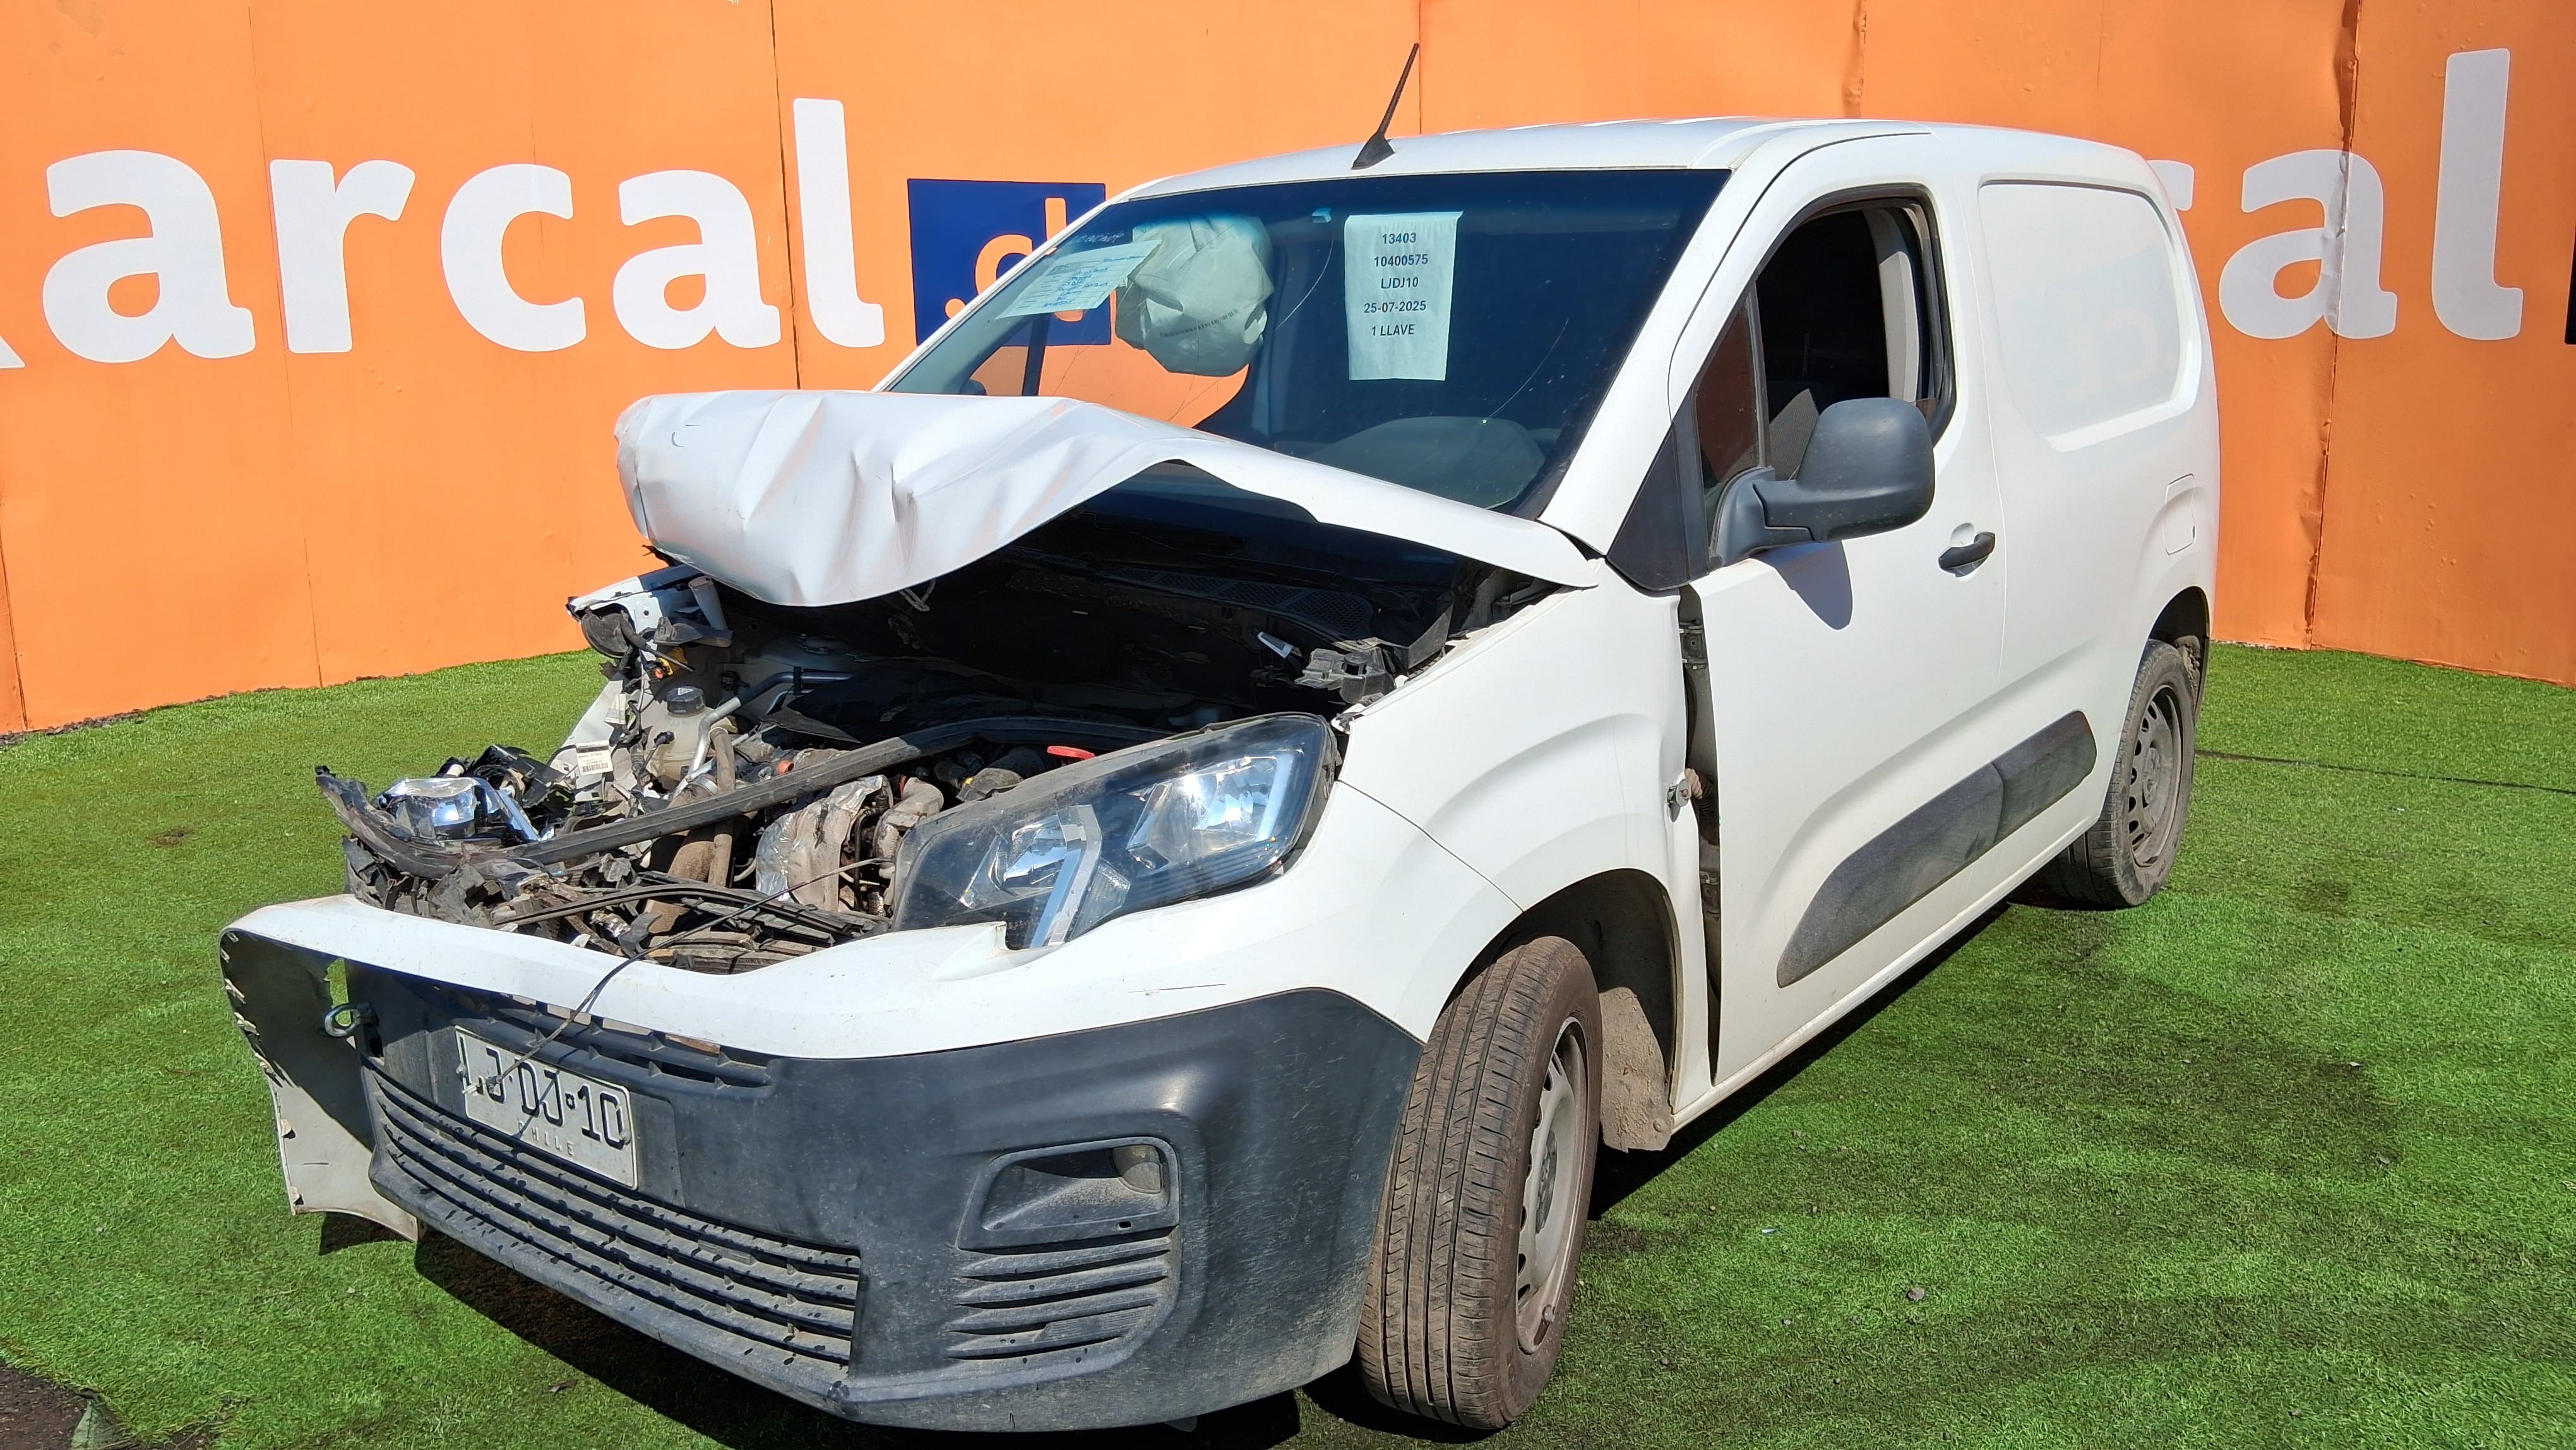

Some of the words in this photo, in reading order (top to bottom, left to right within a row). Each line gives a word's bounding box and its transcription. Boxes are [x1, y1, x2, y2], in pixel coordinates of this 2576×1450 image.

[0, 97, 885, 368] arcal
[1381, 232, 1417, 245] 13403
[1373, 253, 1429, 267] 10400575
[1380, 277, 1419, 289] LJDJ10
[1363, 300, 1427, 314] 25-07-2025
[1371, 326, 1376, 337] 1
[1380, 324, 1416, 337] LLAVE
[517, 1120, 576, 1158] CHILE
